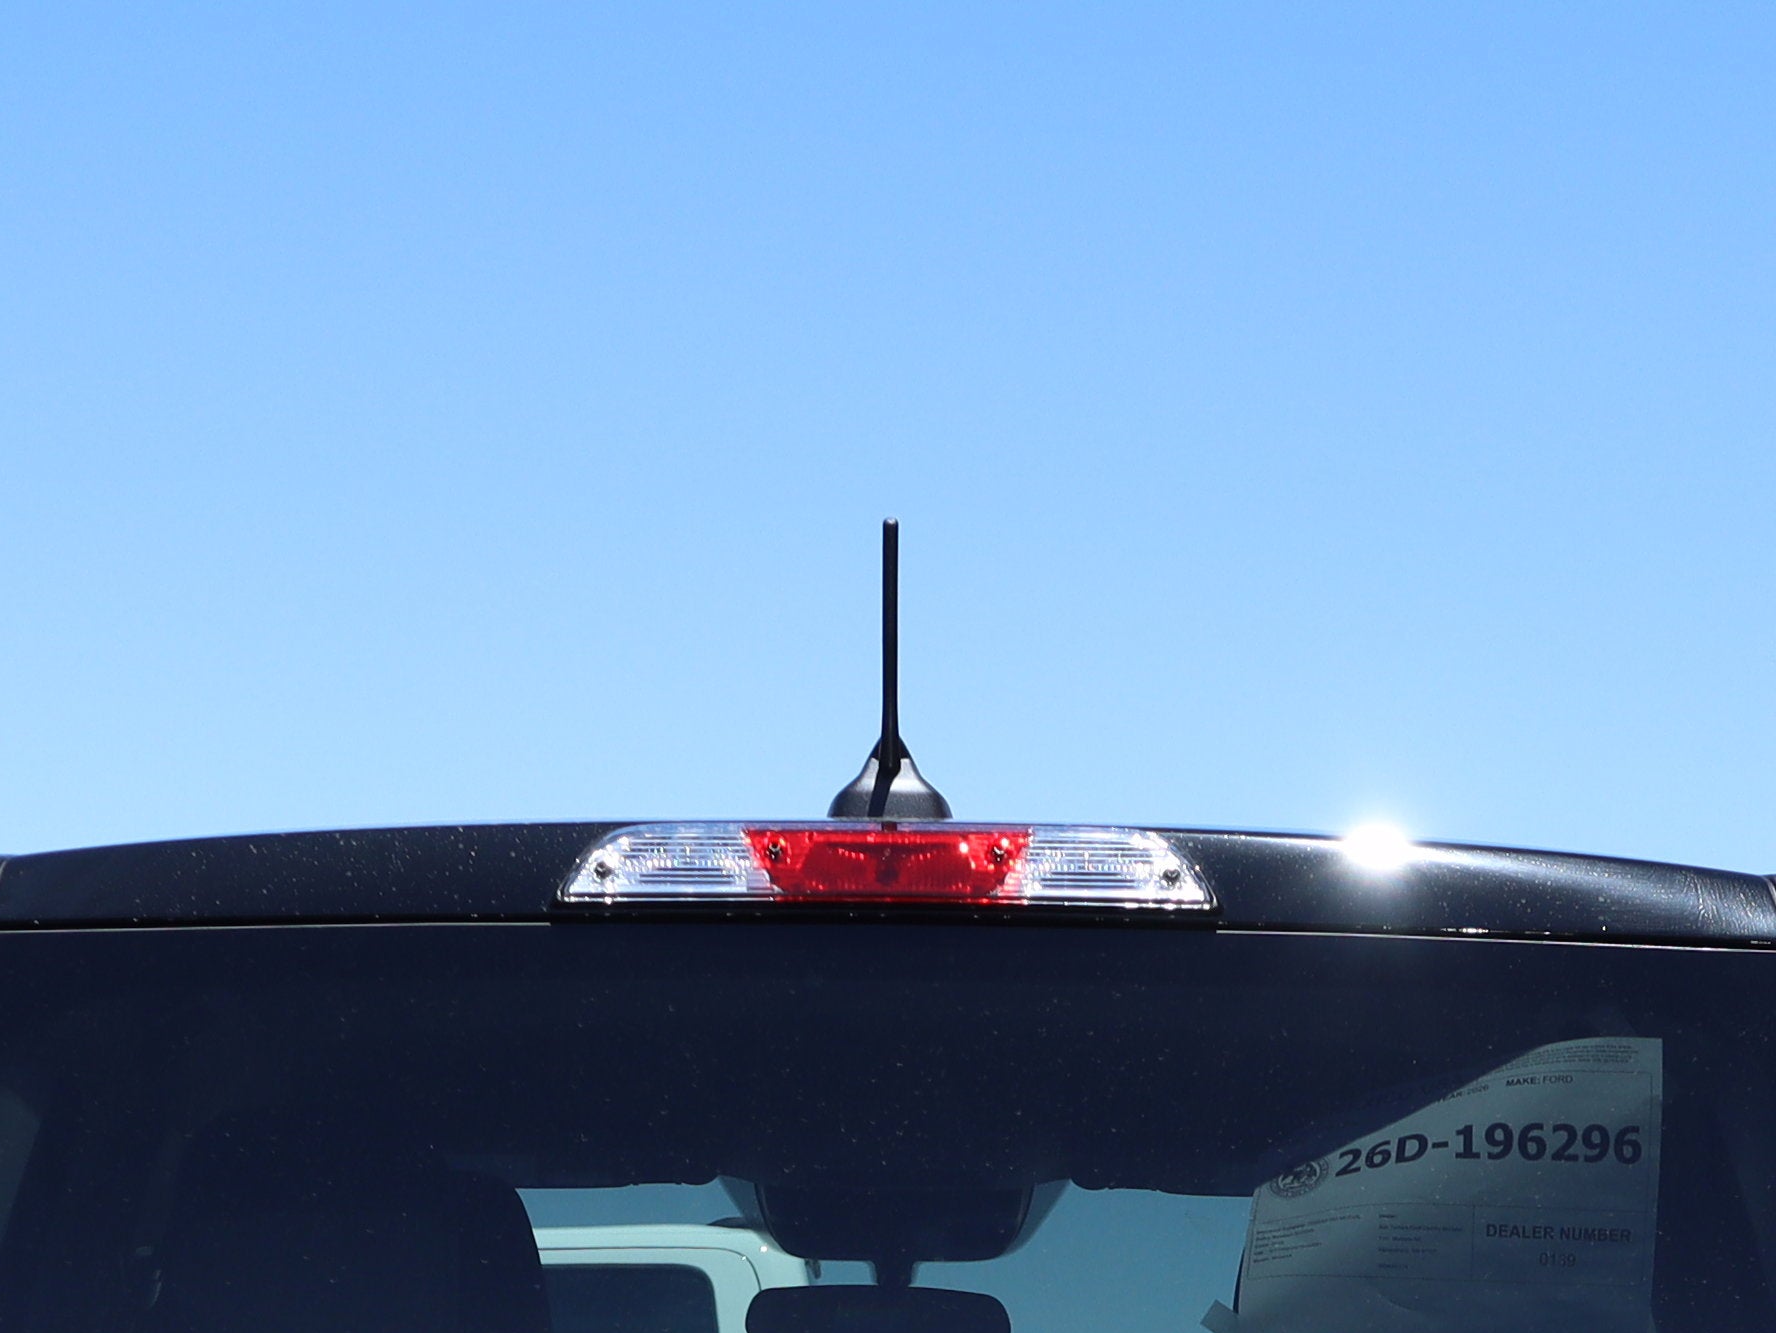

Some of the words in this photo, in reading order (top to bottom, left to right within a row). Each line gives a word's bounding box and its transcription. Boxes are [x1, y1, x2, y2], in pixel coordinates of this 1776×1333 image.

[1505, 1076, 1540, 1086] MAKE:
[1542, 1075, 1573, 1084] FORD
[1335, 1122, 1640, 1176] 26D-196296
[1486, 1224, 1554, 1240] DEALER
[1560, 1227, 1631, 1242] NUMBER
